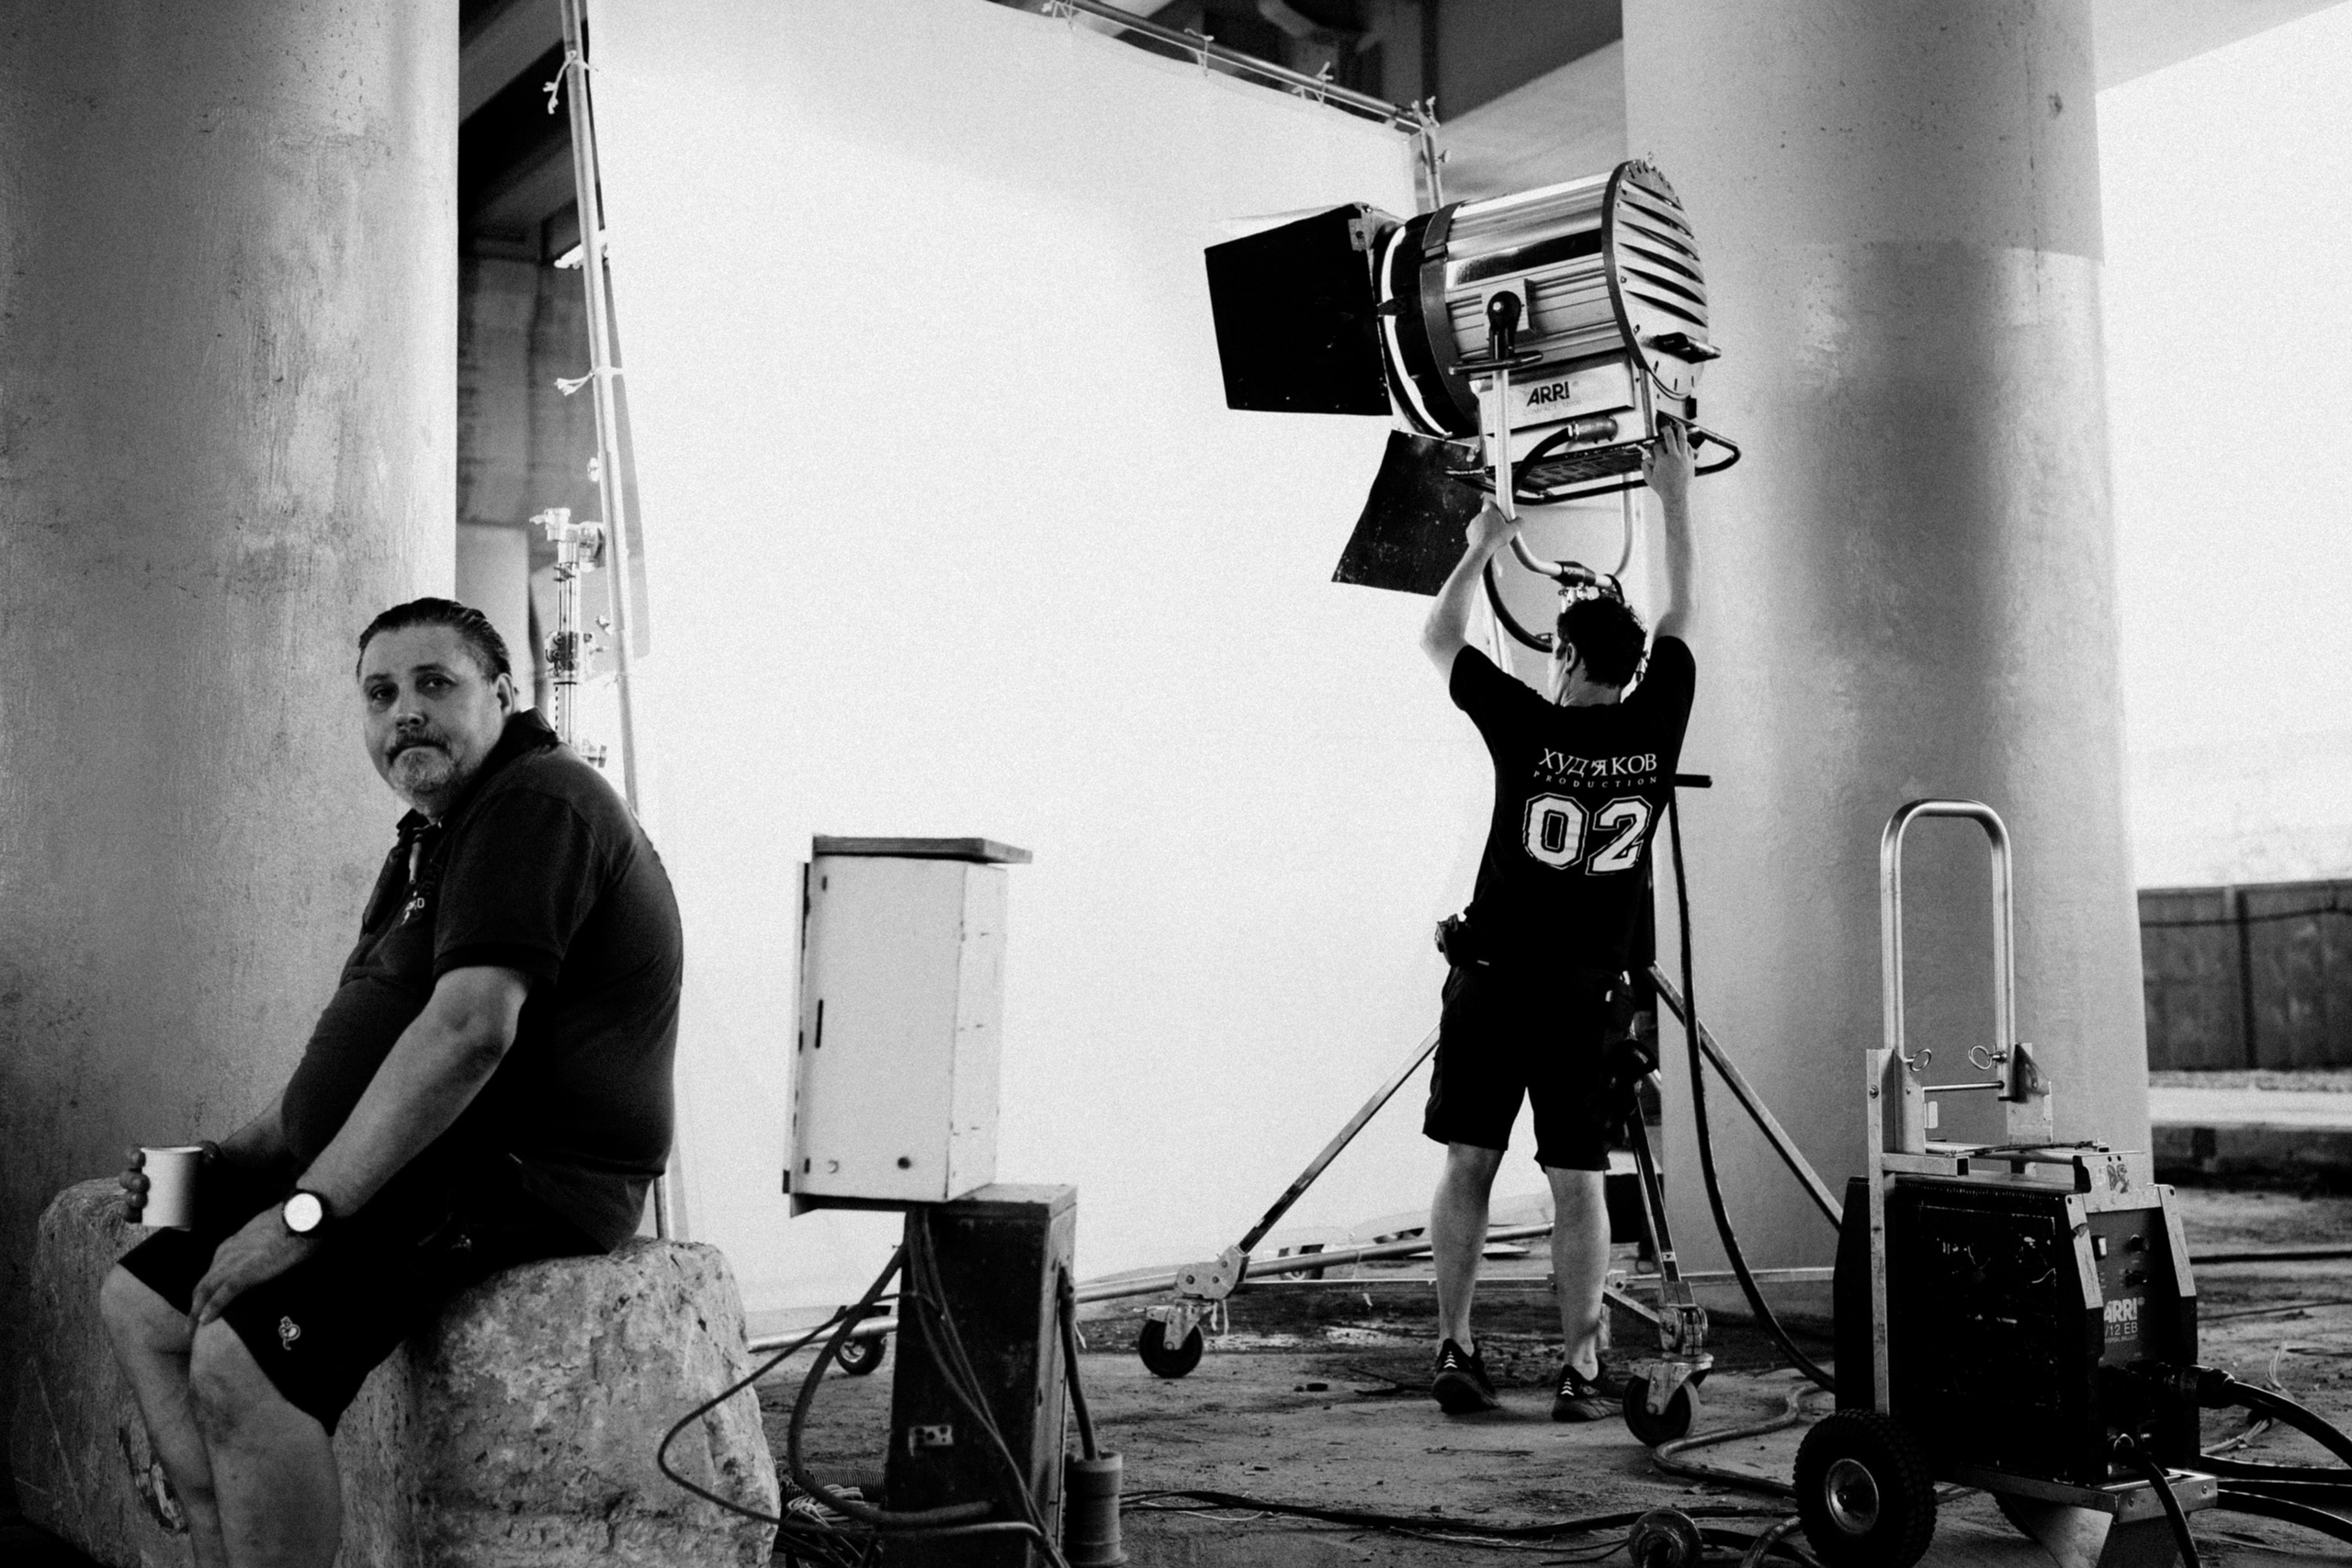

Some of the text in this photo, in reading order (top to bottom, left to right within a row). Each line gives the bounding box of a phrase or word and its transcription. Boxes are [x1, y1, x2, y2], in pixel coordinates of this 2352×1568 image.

[1526, 381, 1570, 407] ARRI
[1538, 748, 1657, 778] ХУДЯКОВ
[1533, 770, 1657, 788] PRODUCTION
[1522, 792, 1653, 876] 02
[2104, 1297, 2137, 1323] ARRI
[2124, 1321, 2138, 1335] EB
